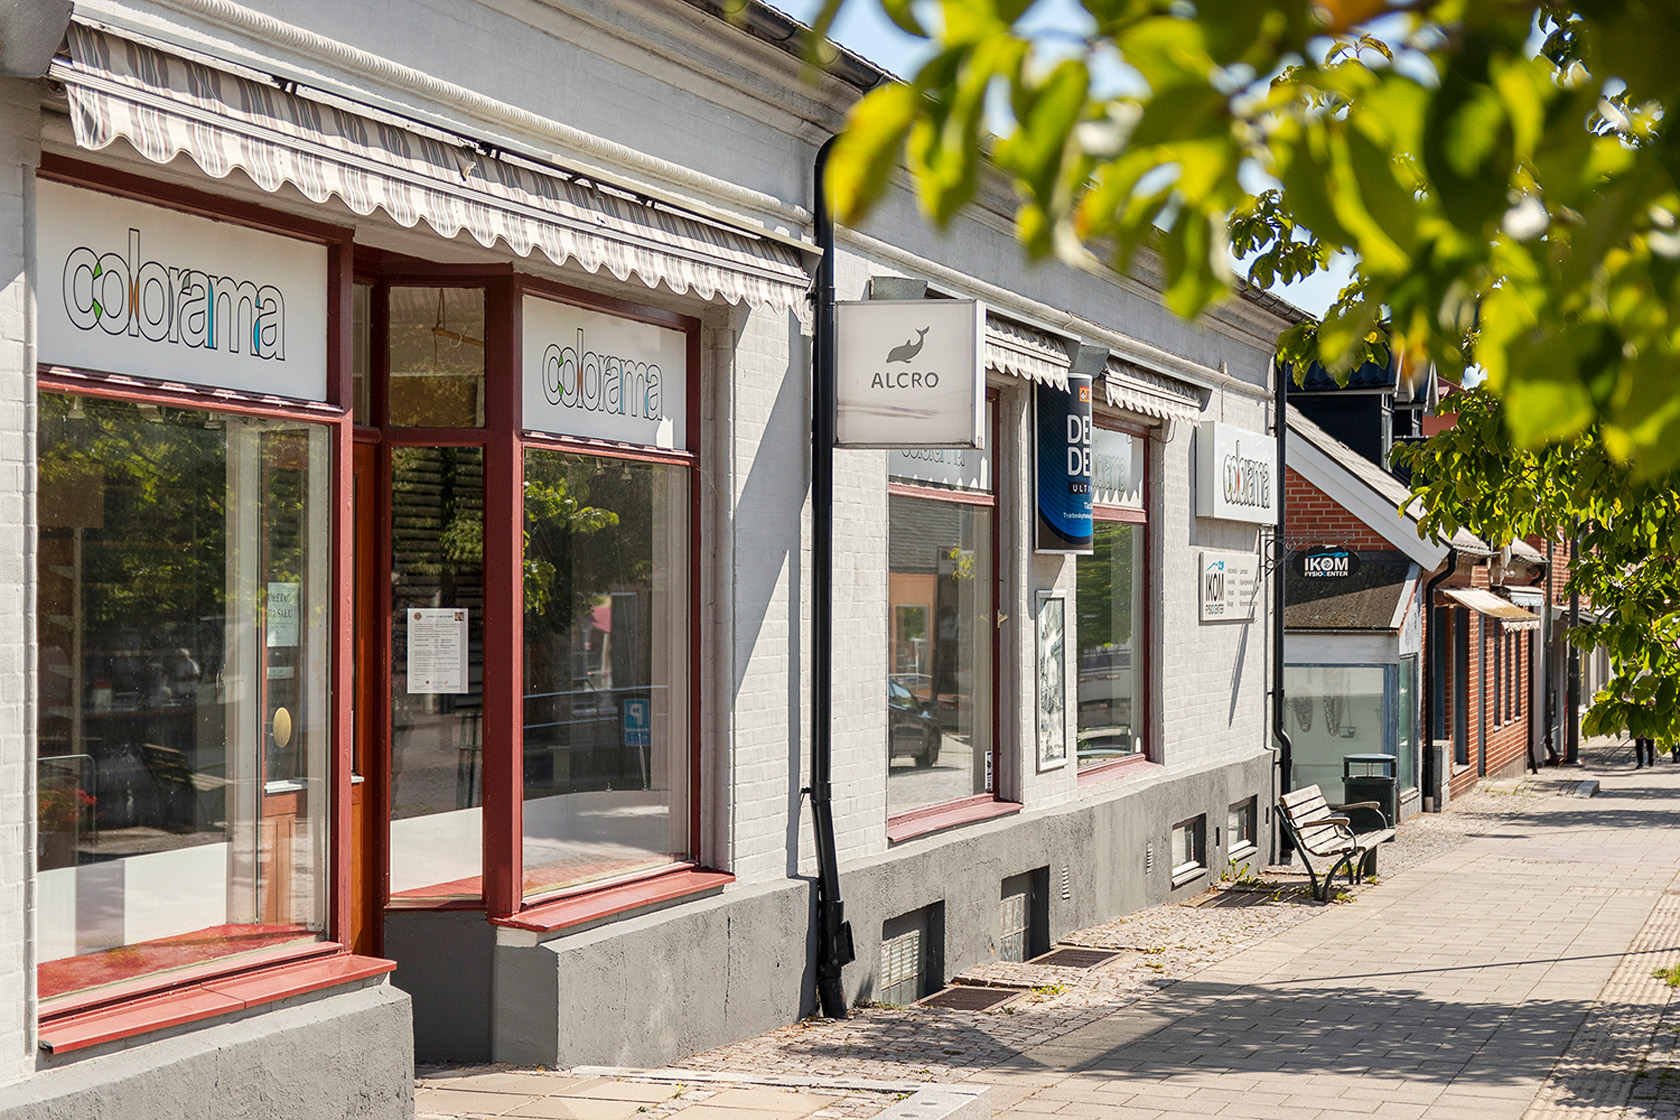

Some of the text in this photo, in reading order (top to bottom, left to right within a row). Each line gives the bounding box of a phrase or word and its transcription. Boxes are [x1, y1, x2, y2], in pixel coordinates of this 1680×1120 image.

[62, 227, 286, 362] colorama
[542, 327, 663, 422] colorama
[871, 372, 939, 389] ALCRO
[1223, 440, 1271, 509] colorama
[1205, 573, 1225, 602] IKOM
[1304, 557, 1349, 571] IKOM
